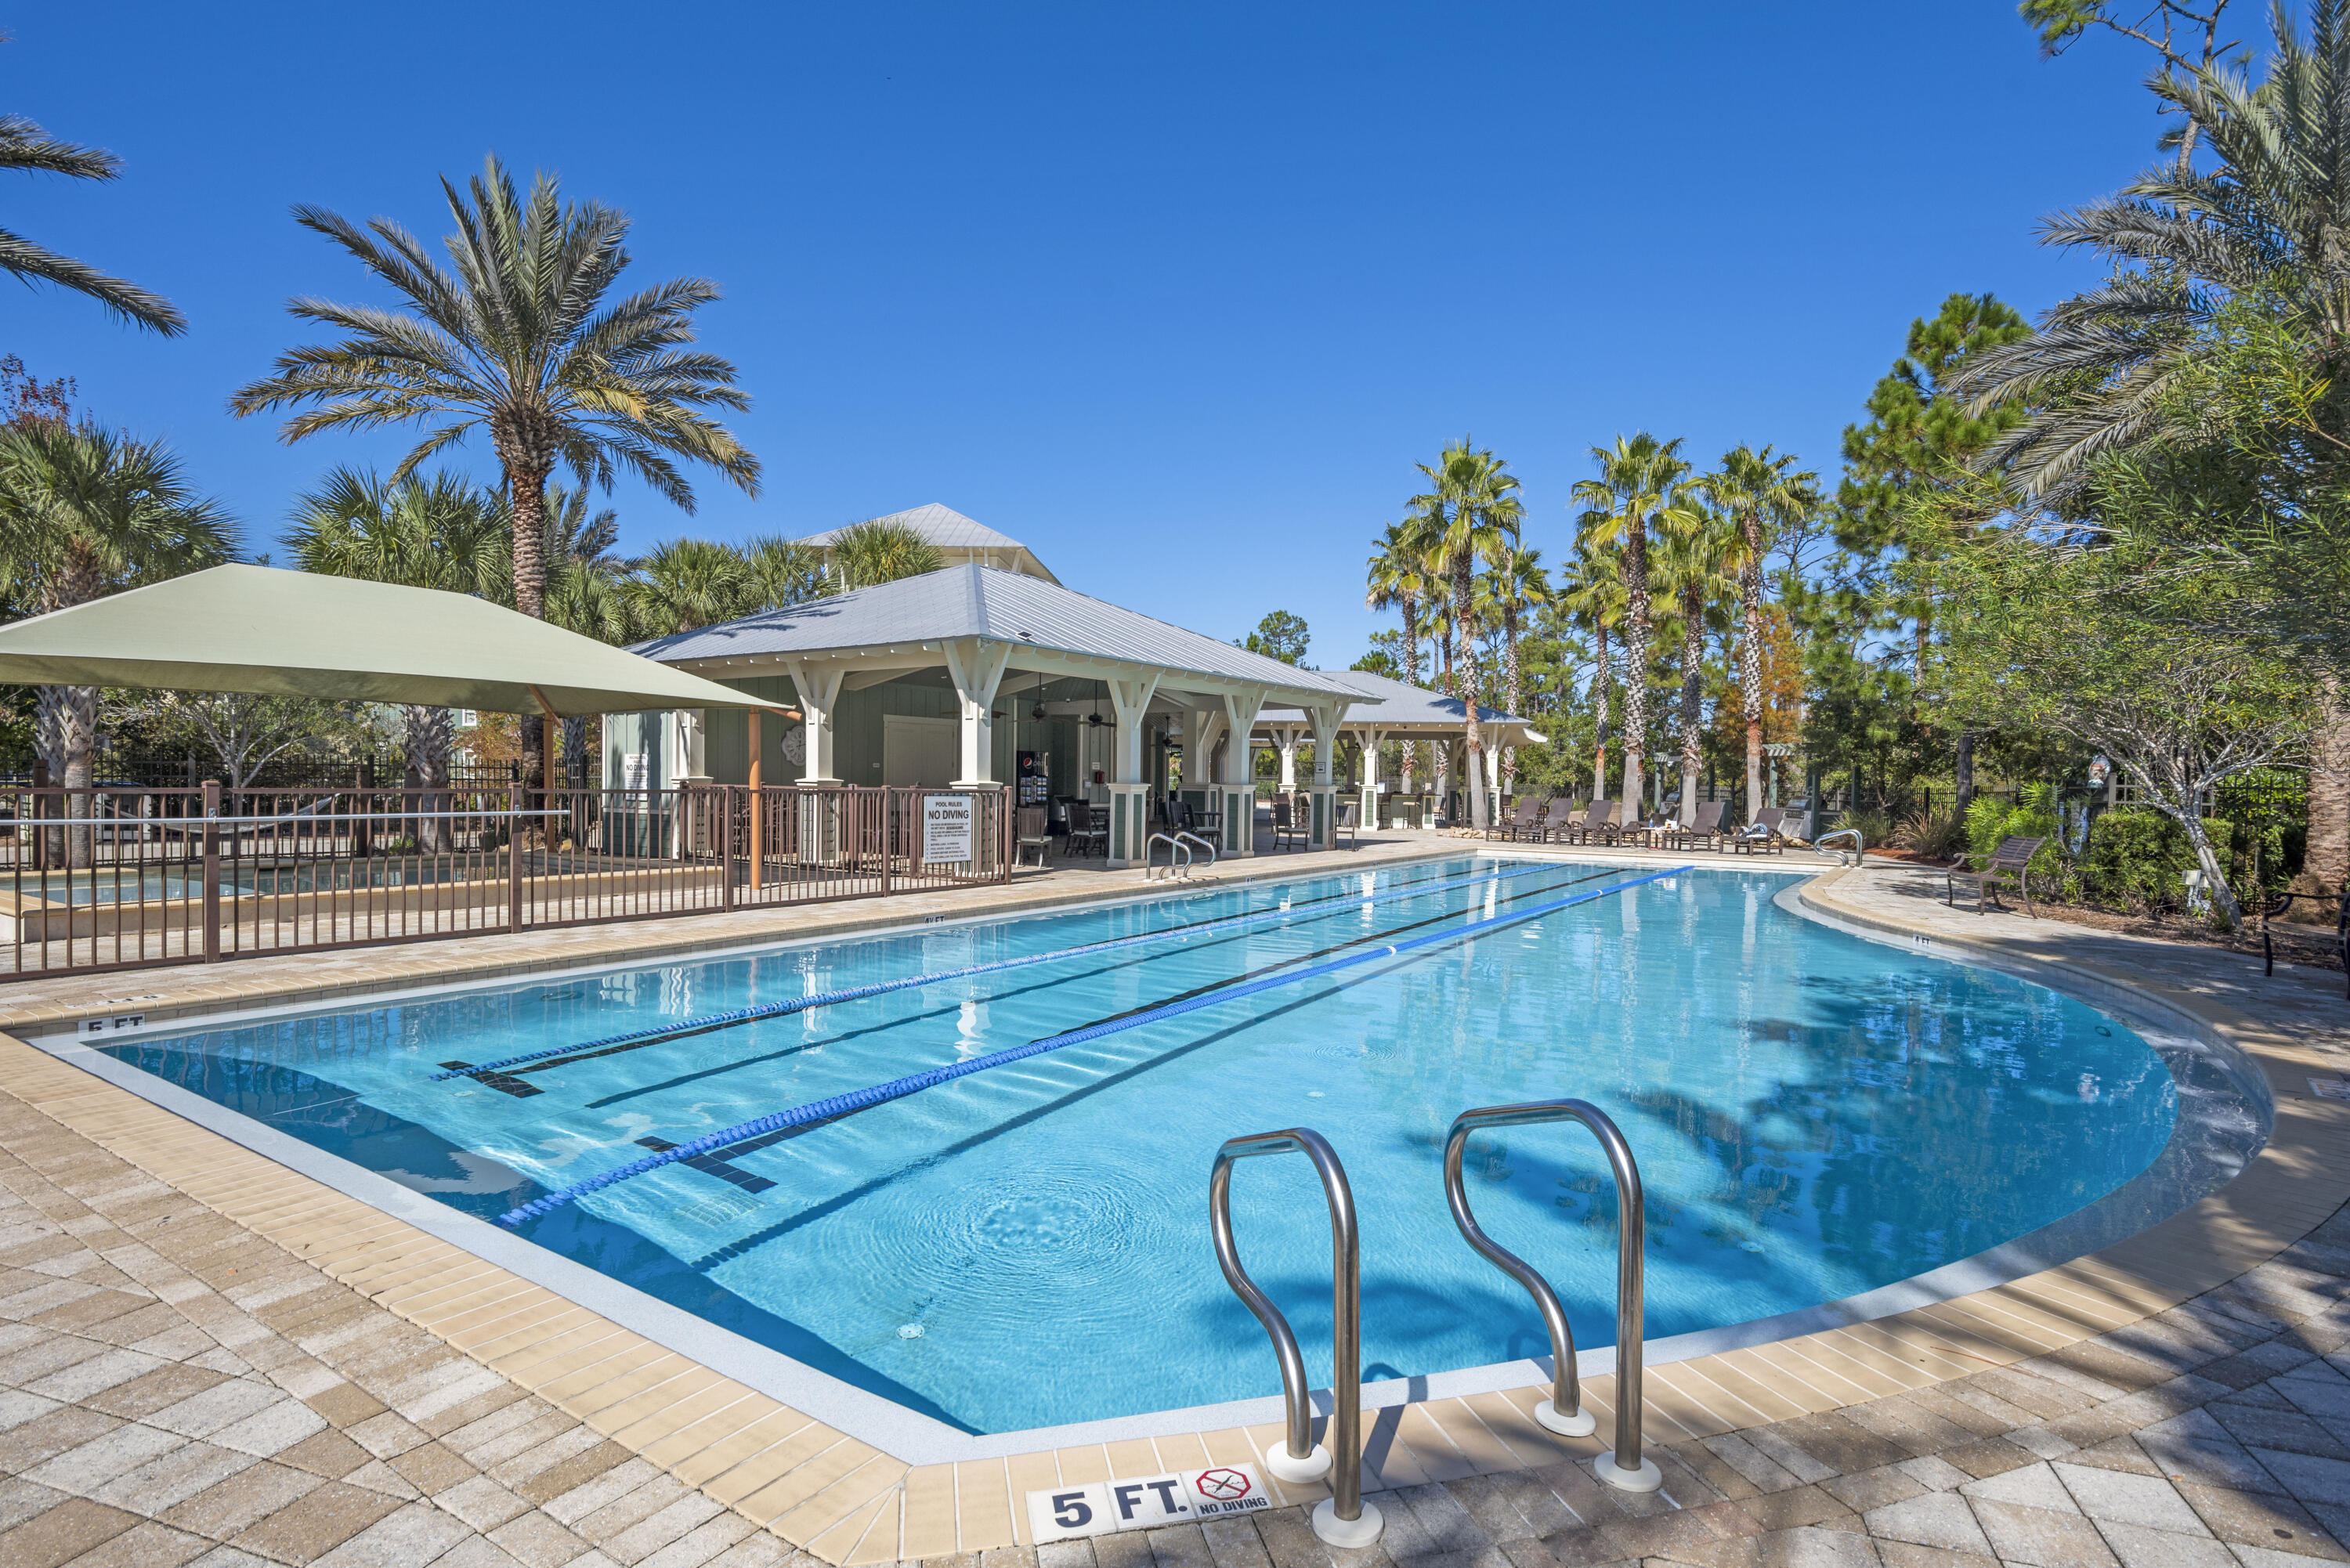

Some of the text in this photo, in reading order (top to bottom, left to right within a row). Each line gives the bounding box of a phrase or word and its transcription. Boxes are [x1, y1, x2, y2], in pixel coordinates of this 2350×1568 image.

[928, 810, 969, 820] NO DIVING
[89, 1015, 143, 1031] 5 FT
[1051, 1479, 1188, 1528] 5 FT.
[1198, 1497, 1268, 1516] NO DIVING
